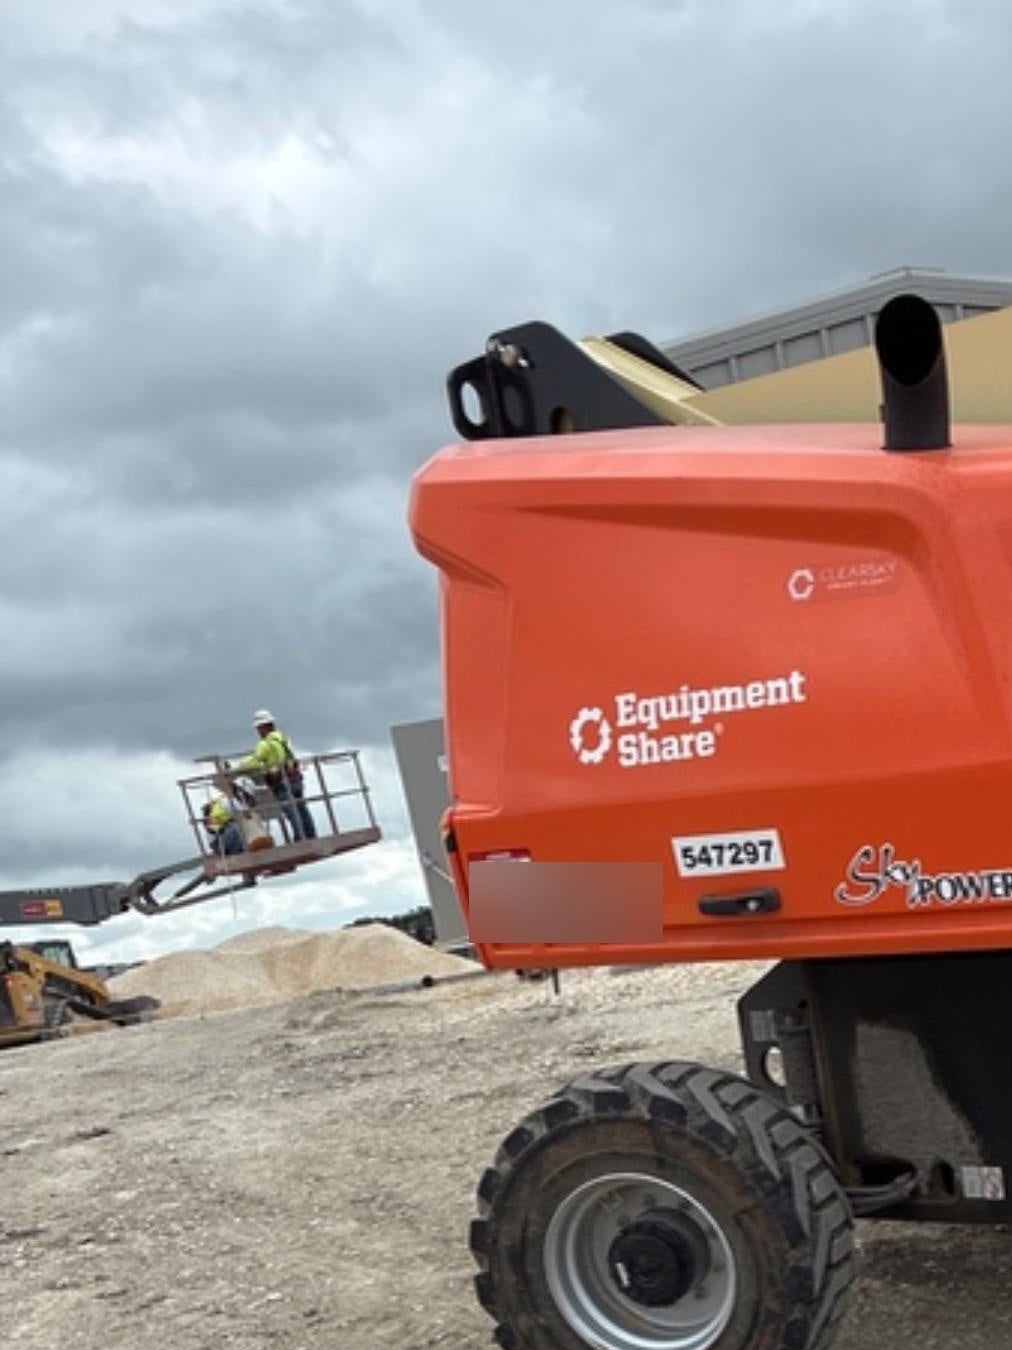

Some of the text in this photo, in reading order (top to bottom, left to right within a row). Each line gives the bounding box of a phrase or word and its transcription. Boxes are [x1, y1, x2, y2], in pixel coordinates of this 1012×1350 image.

[615, 670, 806, 730] Equipment
[617, 730, 715, 768] Share
[680, 839, 775, 869] 547297
